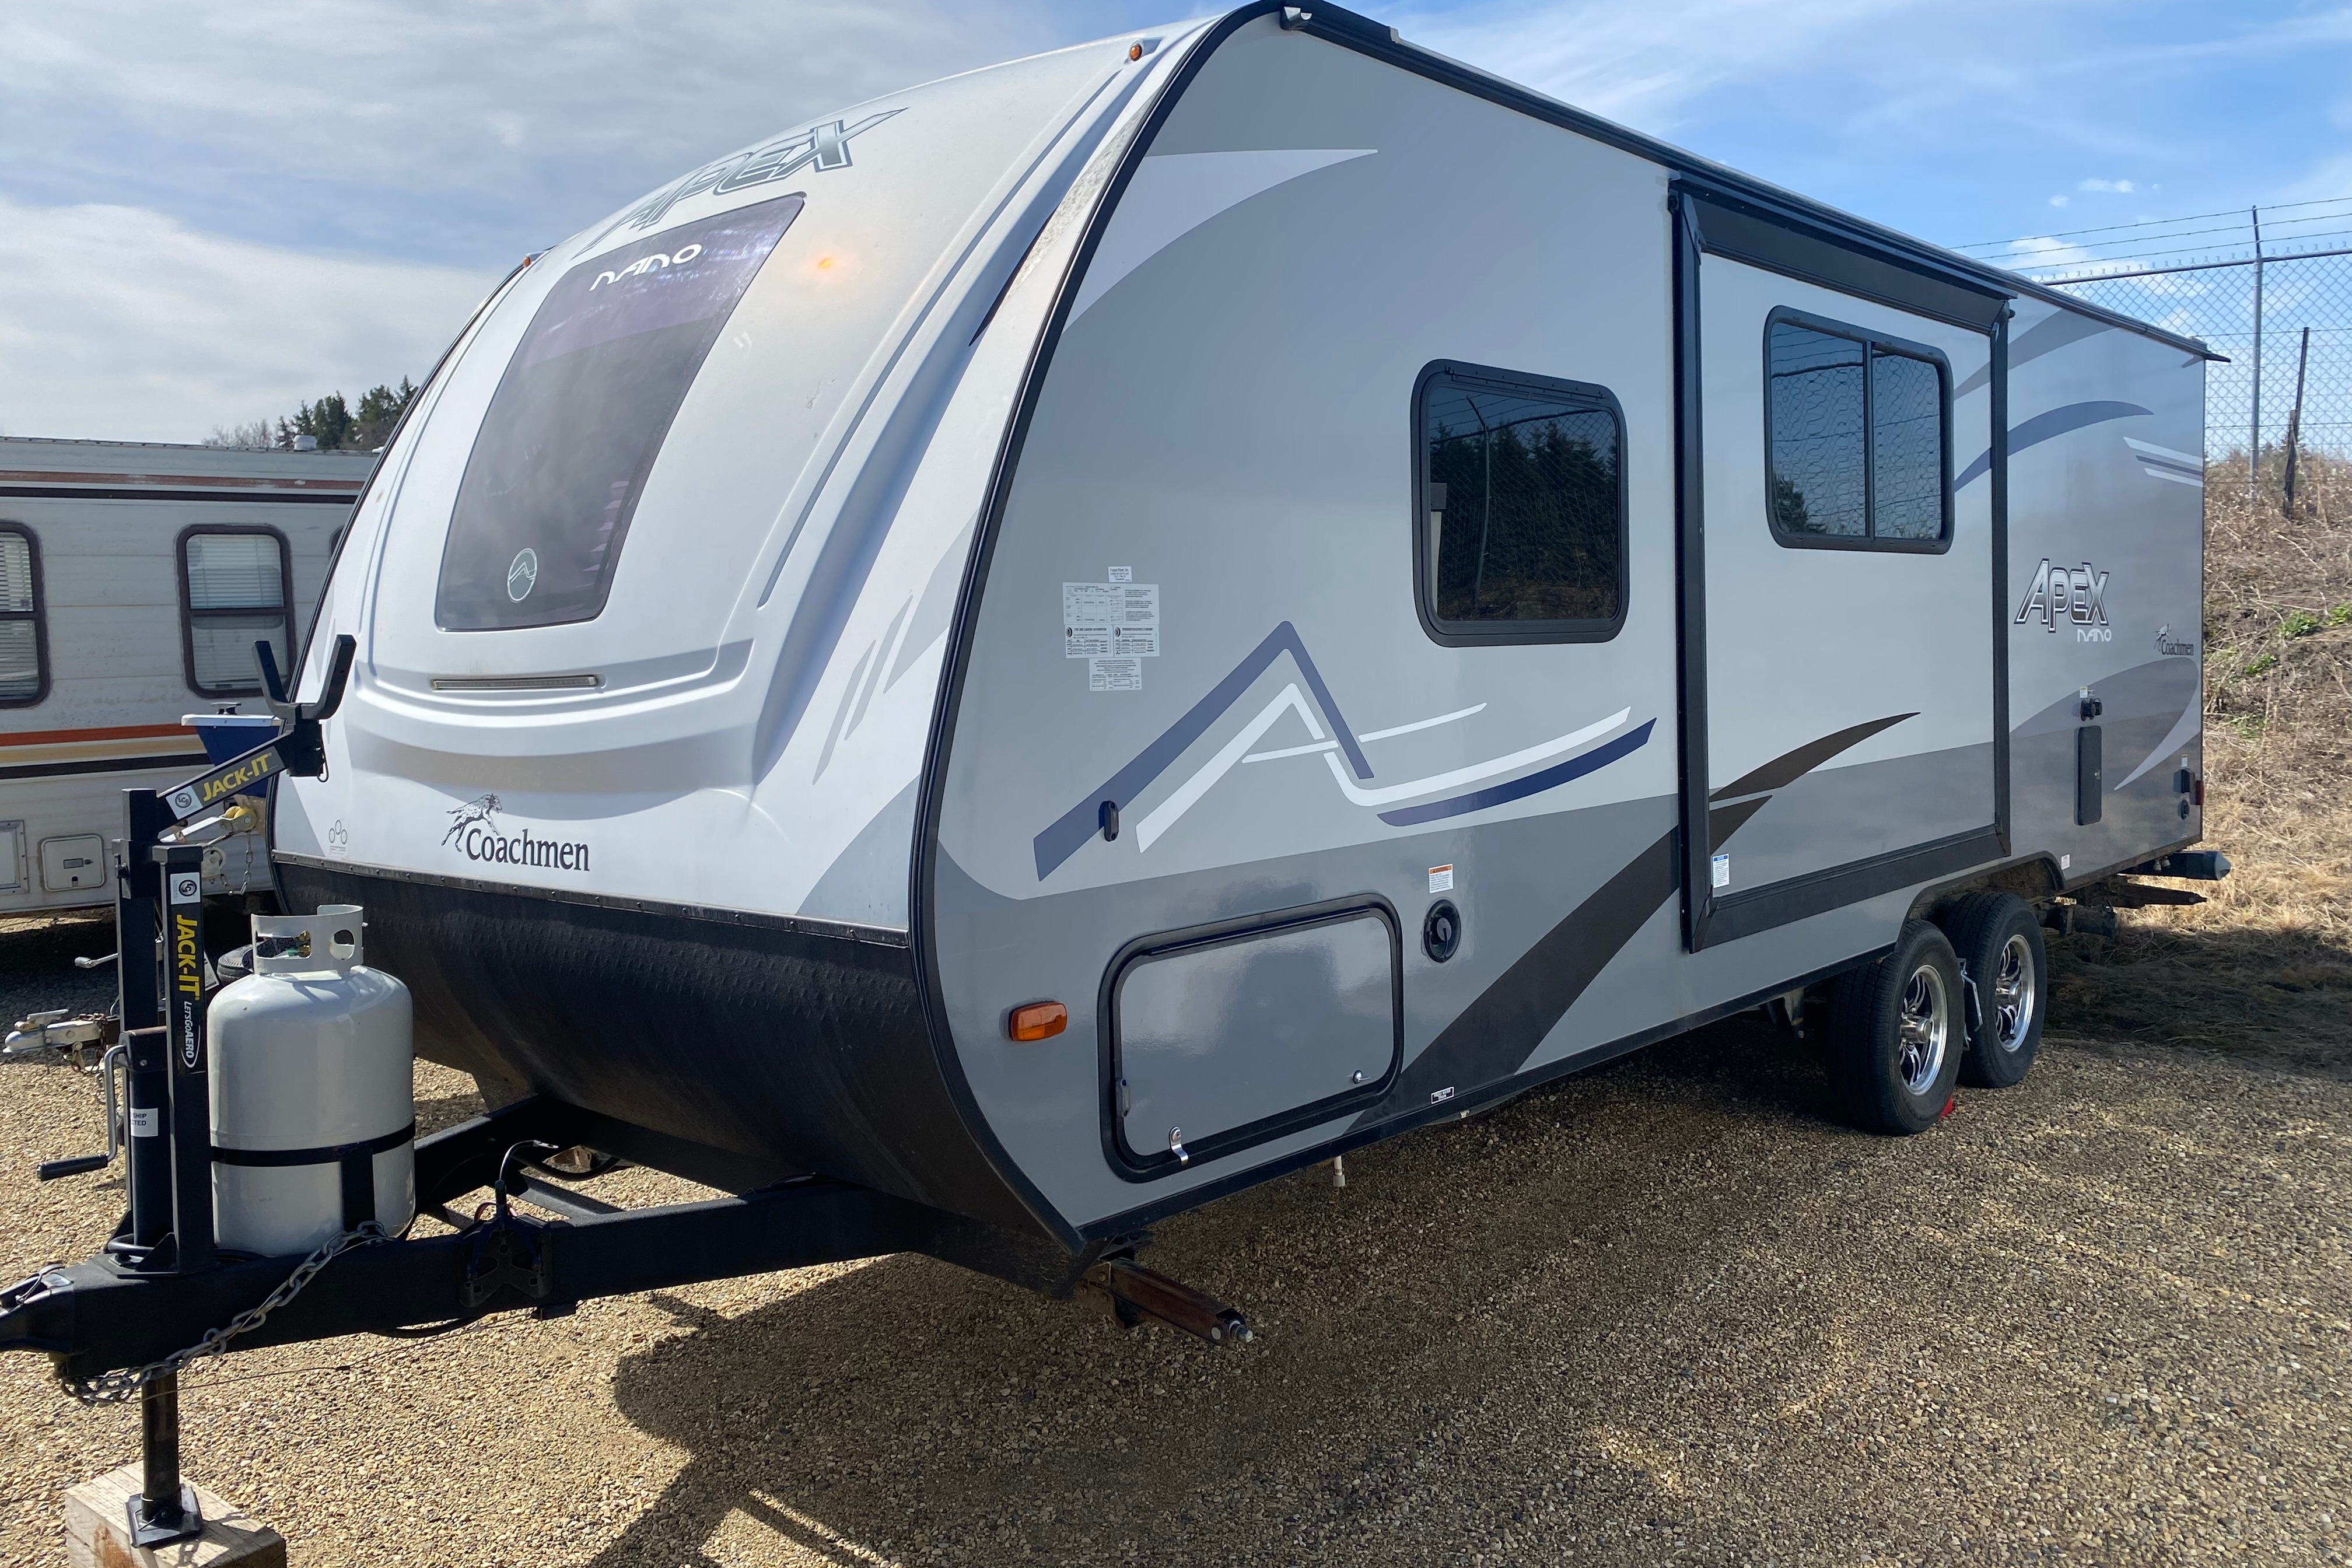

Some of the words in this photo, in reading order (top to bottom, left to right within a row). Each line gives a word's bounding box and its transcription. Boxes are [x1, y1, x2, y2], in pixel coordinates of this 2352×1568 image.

[572, 107, 909, 260] APEX
[589, 243, 702, 291] NANO
[2014, 558, 2109, 633] APEX
[2077, 628, 2112, 642] NANO
[2161, 638, 2194, 656] Coachmen
[203, 753, 269, 802] JACK-IT
[466, 828, 590, 872] Coachmen
[177, 914, 200, 996] JACK-IT
